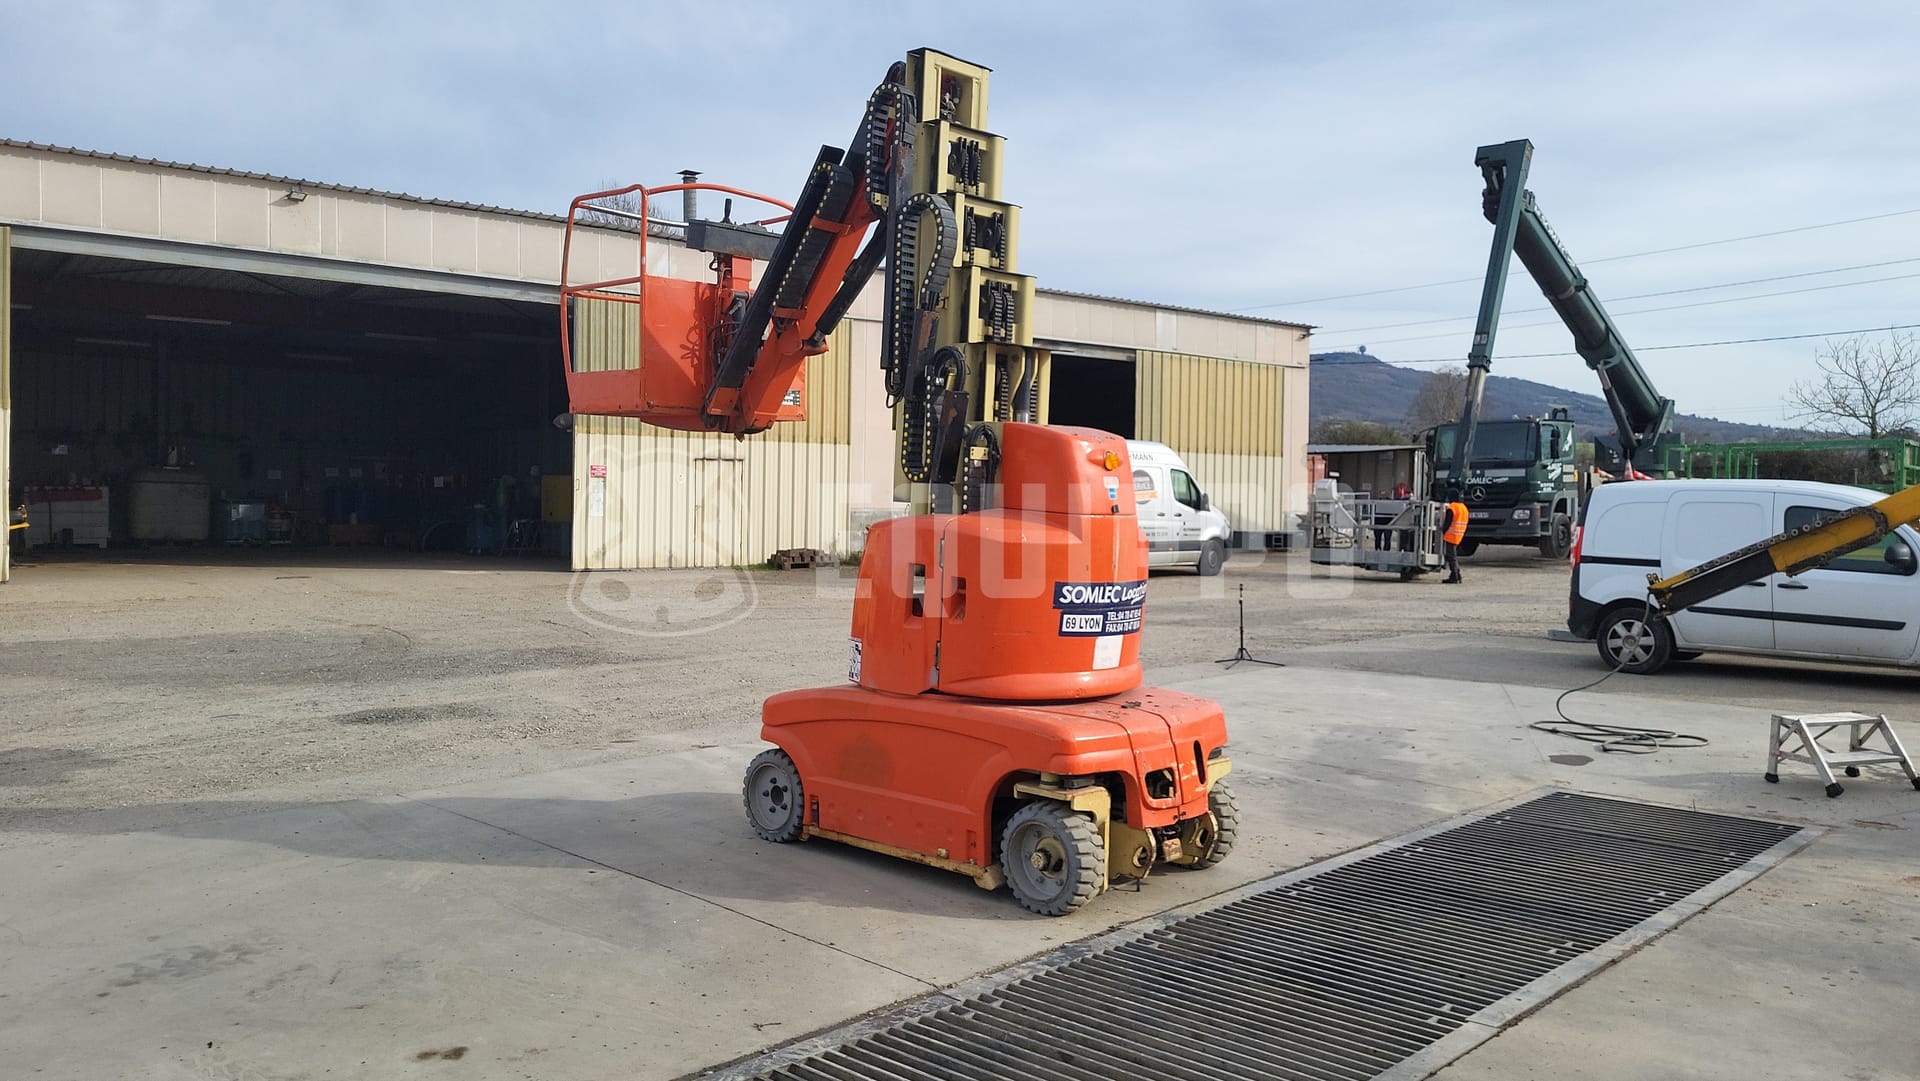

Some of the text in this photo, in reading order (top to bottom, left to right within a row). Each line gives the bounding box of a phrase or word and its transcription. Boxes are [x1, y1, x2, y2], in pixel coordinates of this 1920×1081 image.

[1465, 477, 1493, 485] OMLEC
[1059, 585, 1121, 604] SOMLEC
[1065, 617, 1101, 630] 69 LYON
